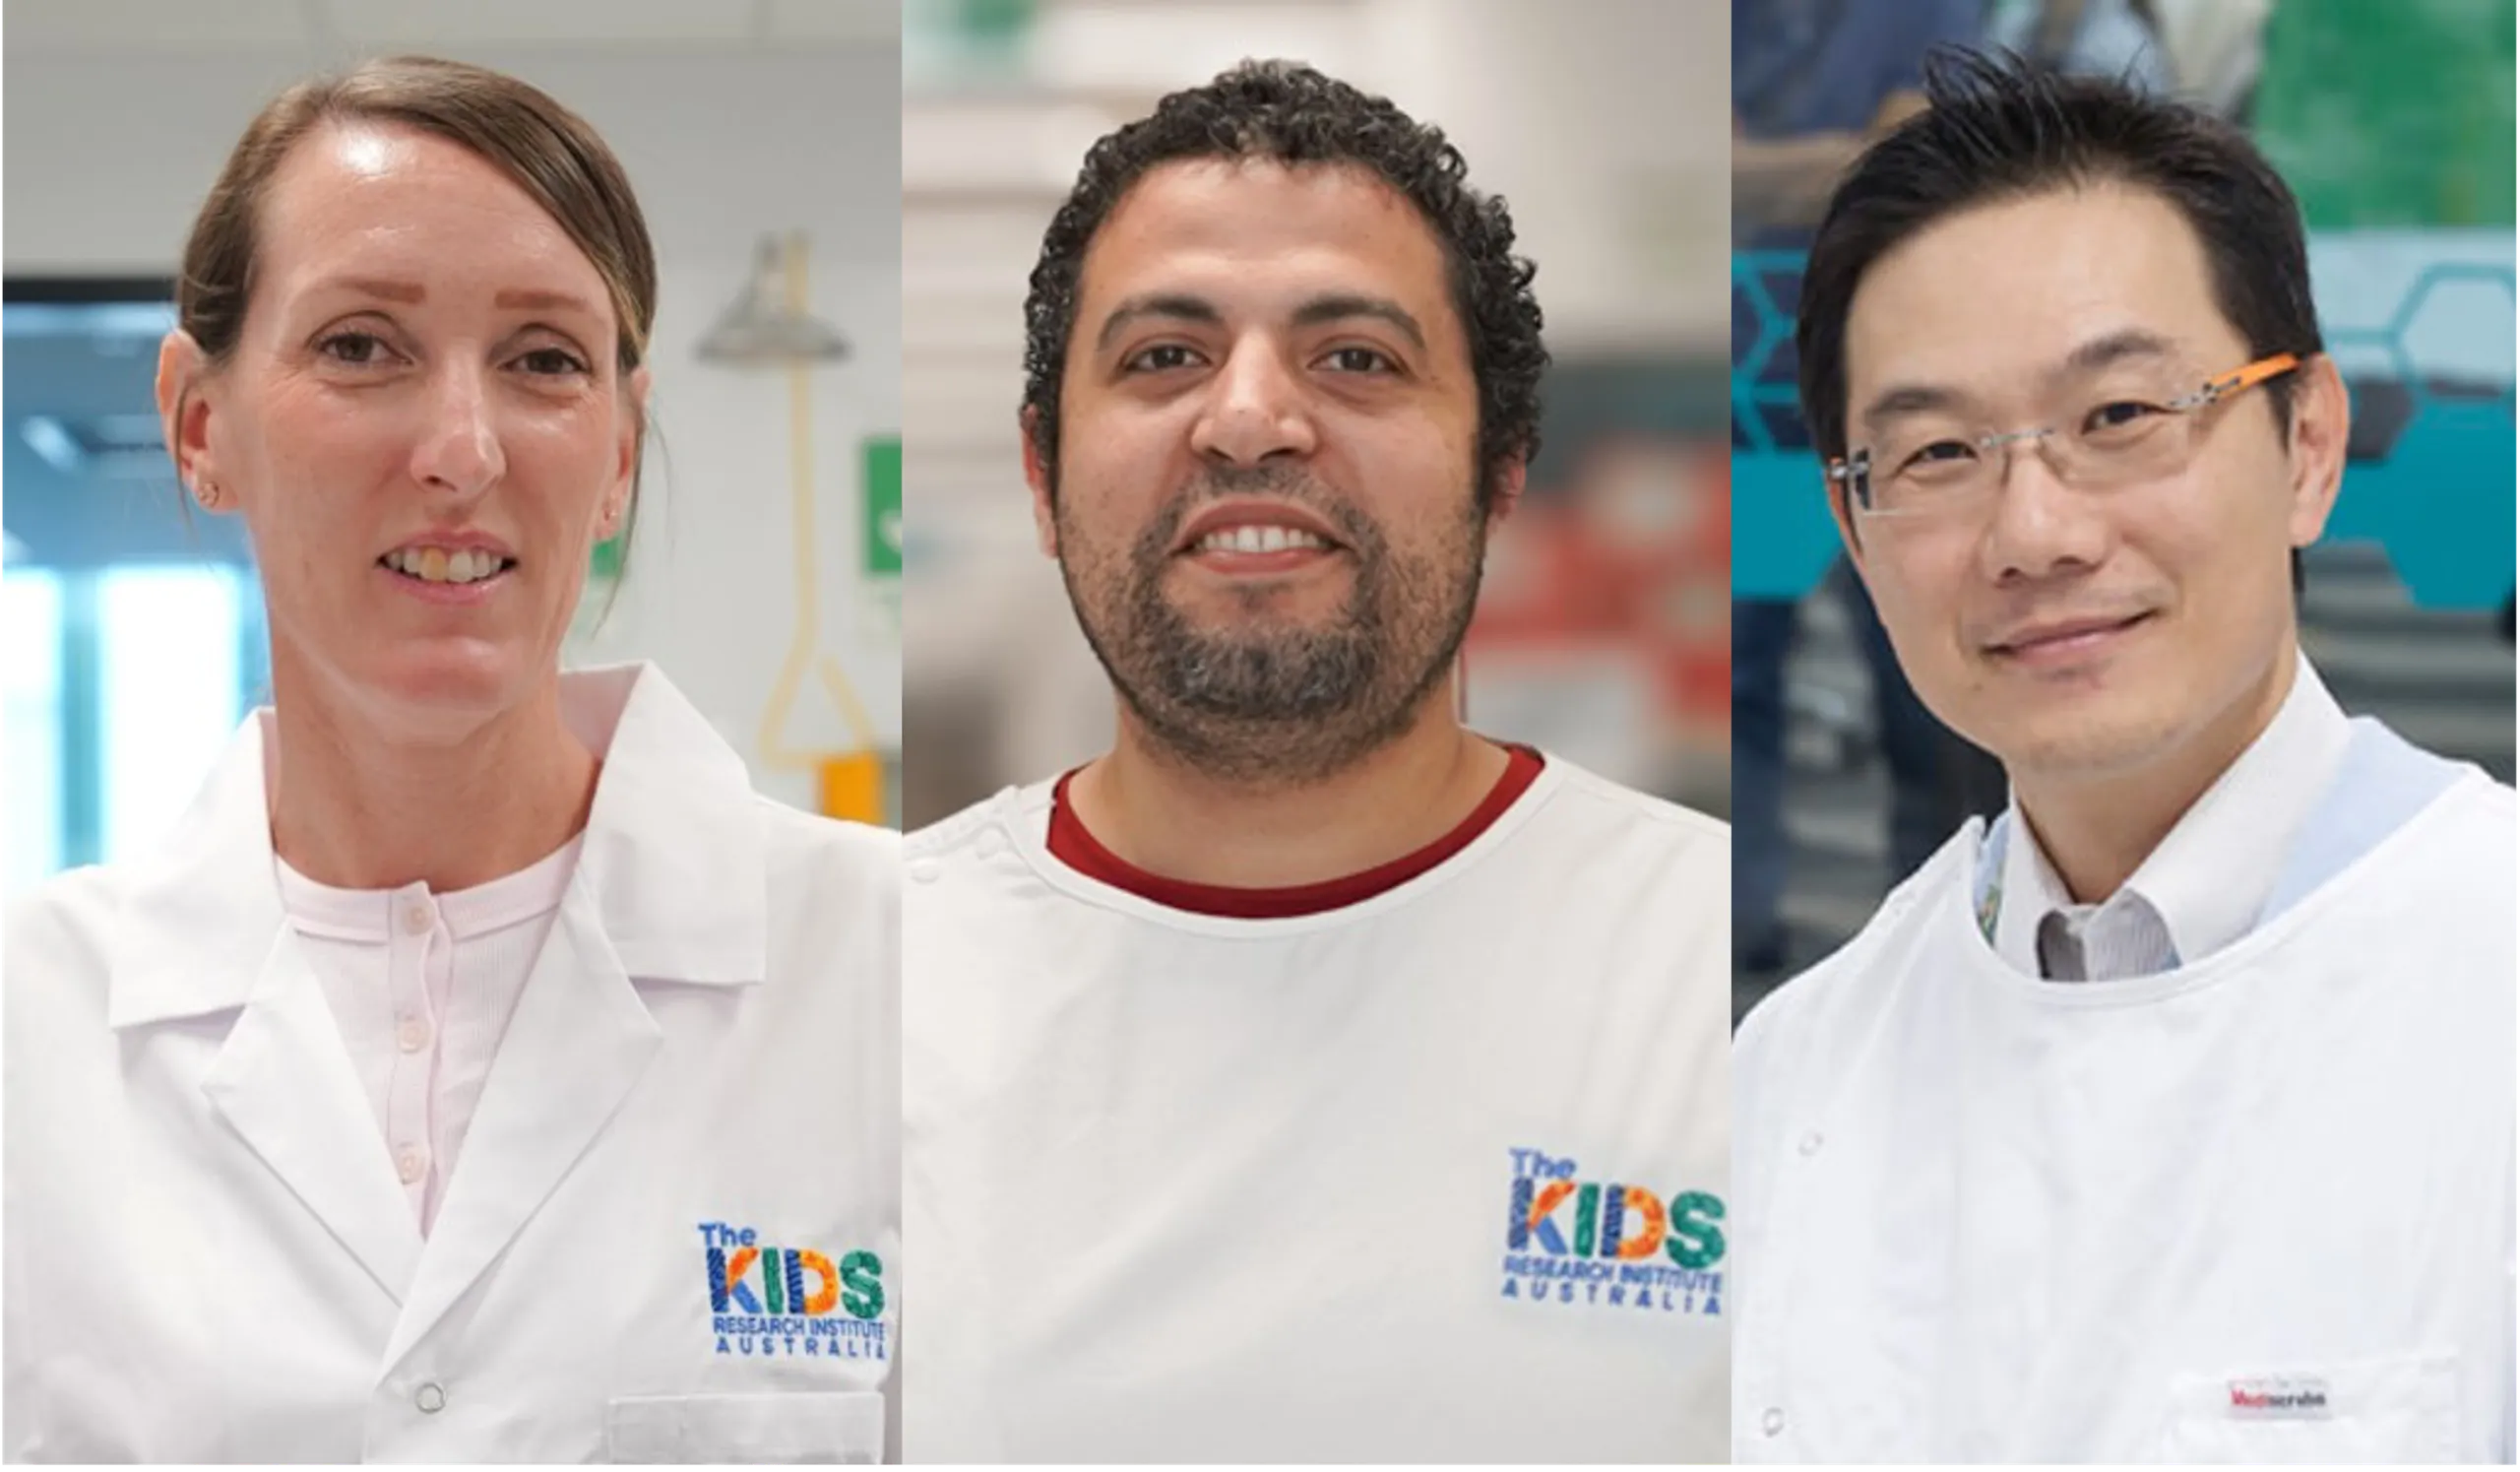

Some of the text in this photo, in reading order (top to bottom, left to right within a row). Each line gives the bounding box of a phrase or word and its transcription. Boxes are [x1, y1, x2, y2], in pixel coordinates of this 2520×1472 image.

[1509, 1148, 1577, 1178] The
[698, 1222, 756, 1247] The
[1507, 1178, 1726, 1269] KIDS
[1503, 1255, 1614, 1281] RESEARCH
[706, 1247, 885, 1319] KIDS
[1501, 1278, 1722, 1314] AUSTRALIA
[713, 1316, 885, 1341] RESEARCH INSTITUTE
[716, 1336, 886, 1359] AUSTRALIA
